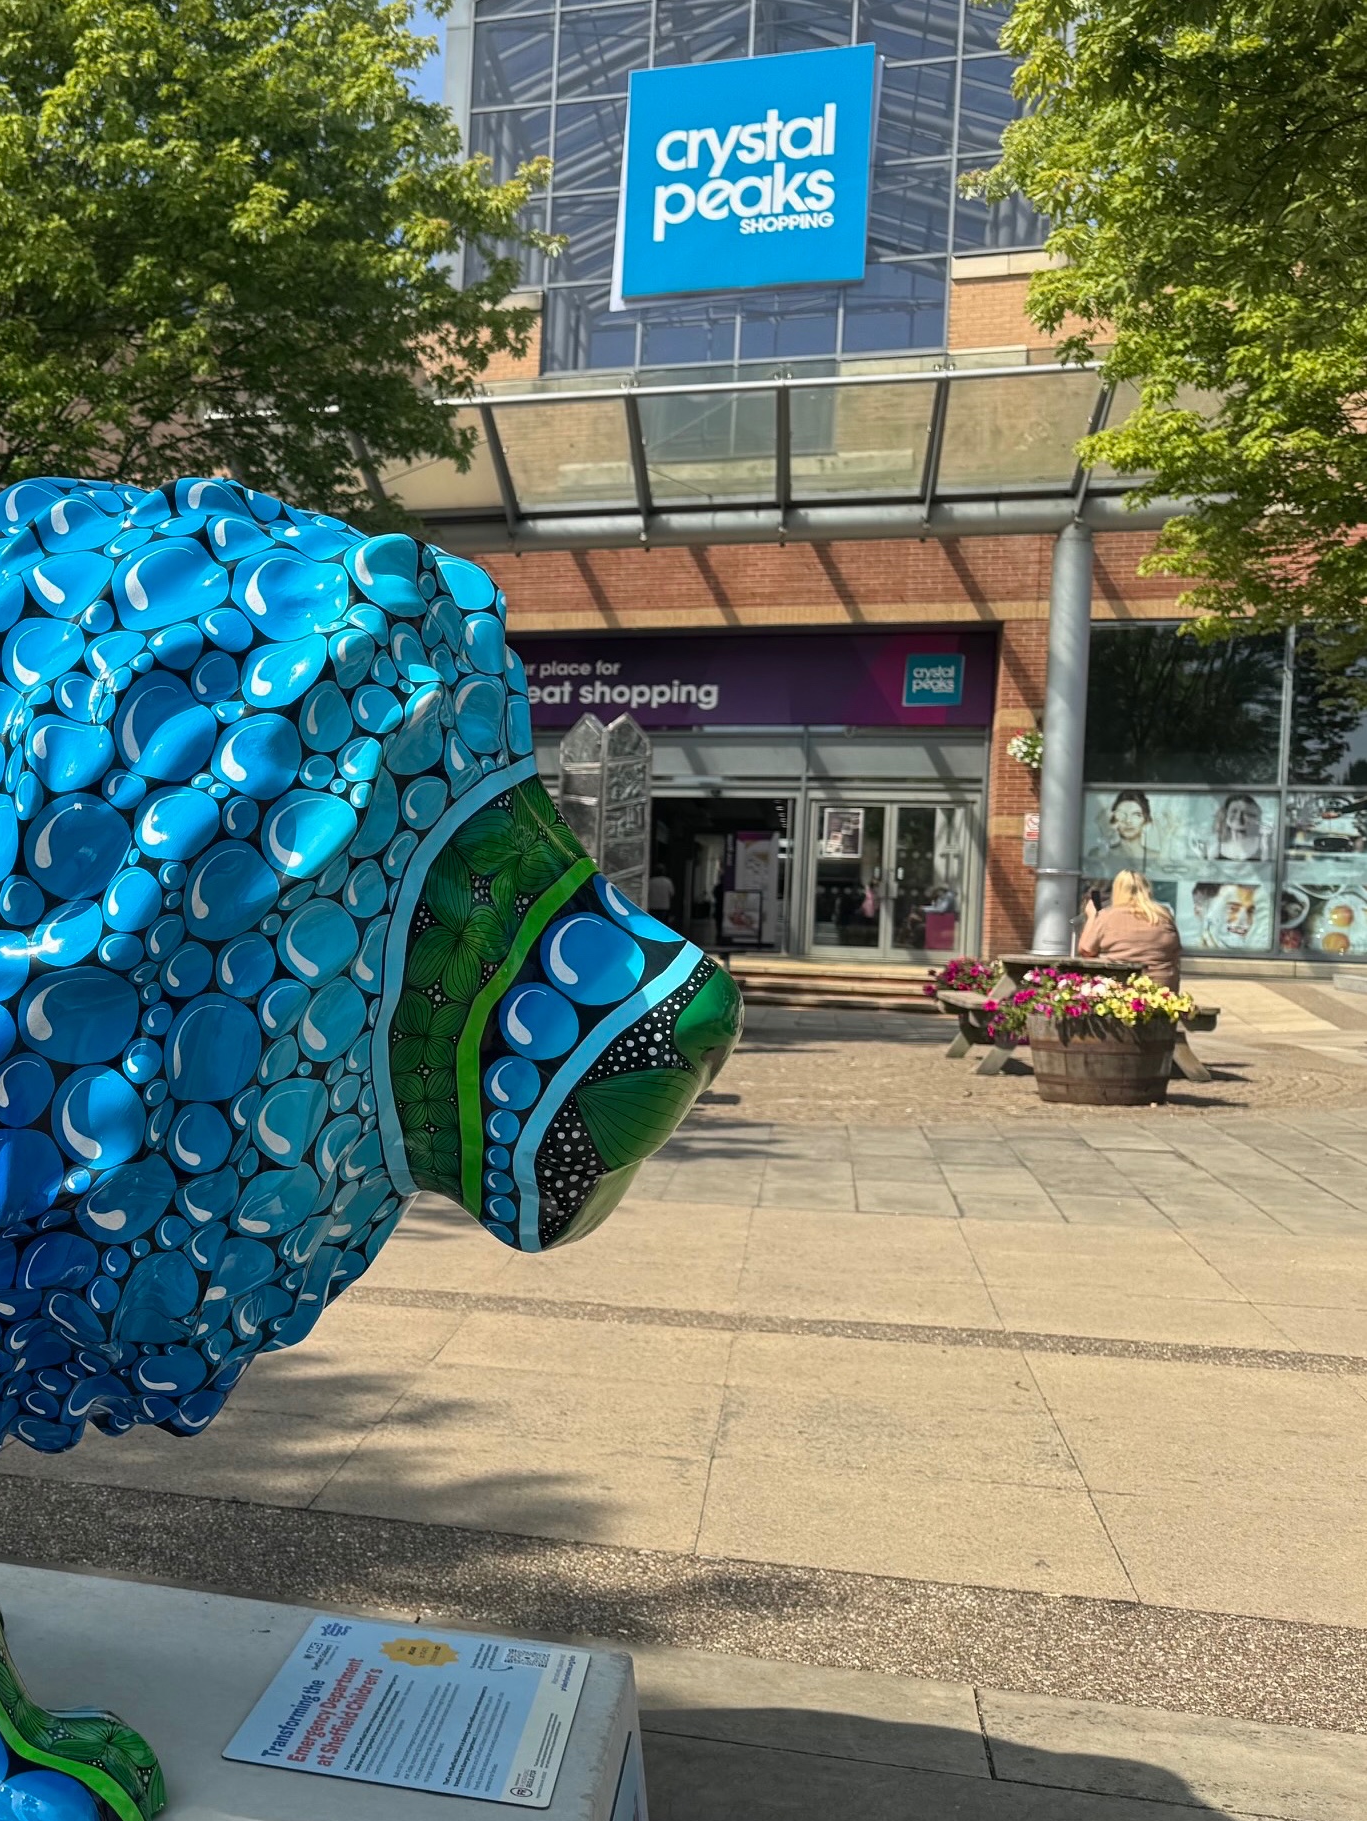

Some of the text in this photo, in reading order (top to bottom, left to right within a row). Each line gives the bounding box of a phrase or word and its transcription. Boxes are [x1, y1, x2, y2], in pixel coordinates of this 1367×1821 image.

[655, 102, 837, 178] crystal
[652, 161, 836, 243] peaks
[739, 211, 835, 235] SHOPPING
[527, 679, 719, 710] eat shopping
[539, 660, 592, 679] place
[595, 659, 622, 676] for
[912, 678, 955, 694] peaks
[913, 665, 955, 681] crystal
[260, 1693, 321, 1759] Transforming
[300, 1678, 325, 1695] the
[285, 1708, 338, 1763] Emergency
[318, 1657, 366, 1710] Department
[312, 1667, 383, 1766] at Sheffield Children's
